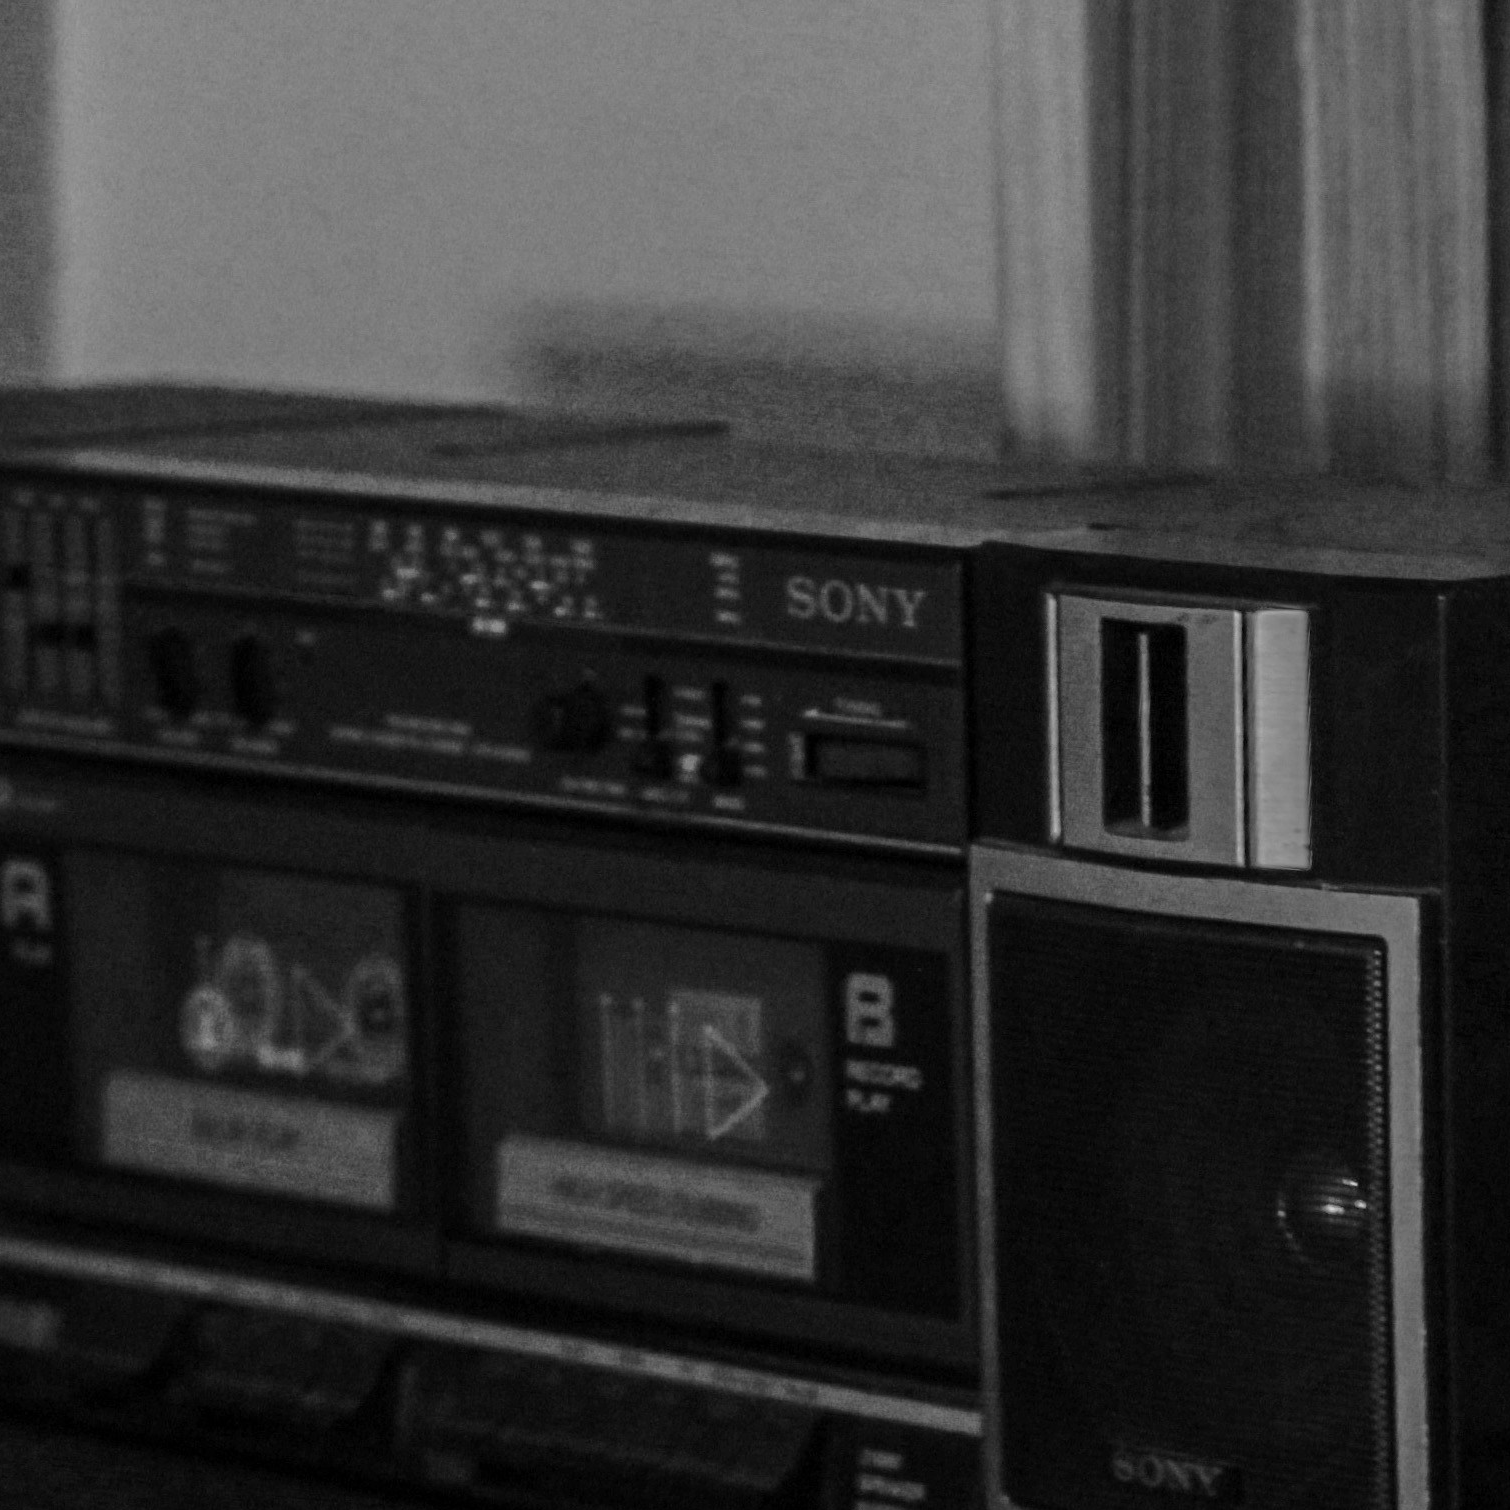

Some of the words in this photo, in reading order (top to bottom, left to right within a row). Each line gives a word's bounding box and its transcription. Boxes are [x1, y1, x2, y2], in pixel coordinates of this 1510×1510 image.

[785, 575, 927, 629] SONY
[845, 972, 896, 1048] B
[1111, 1449, 1224, 1498] SONY
